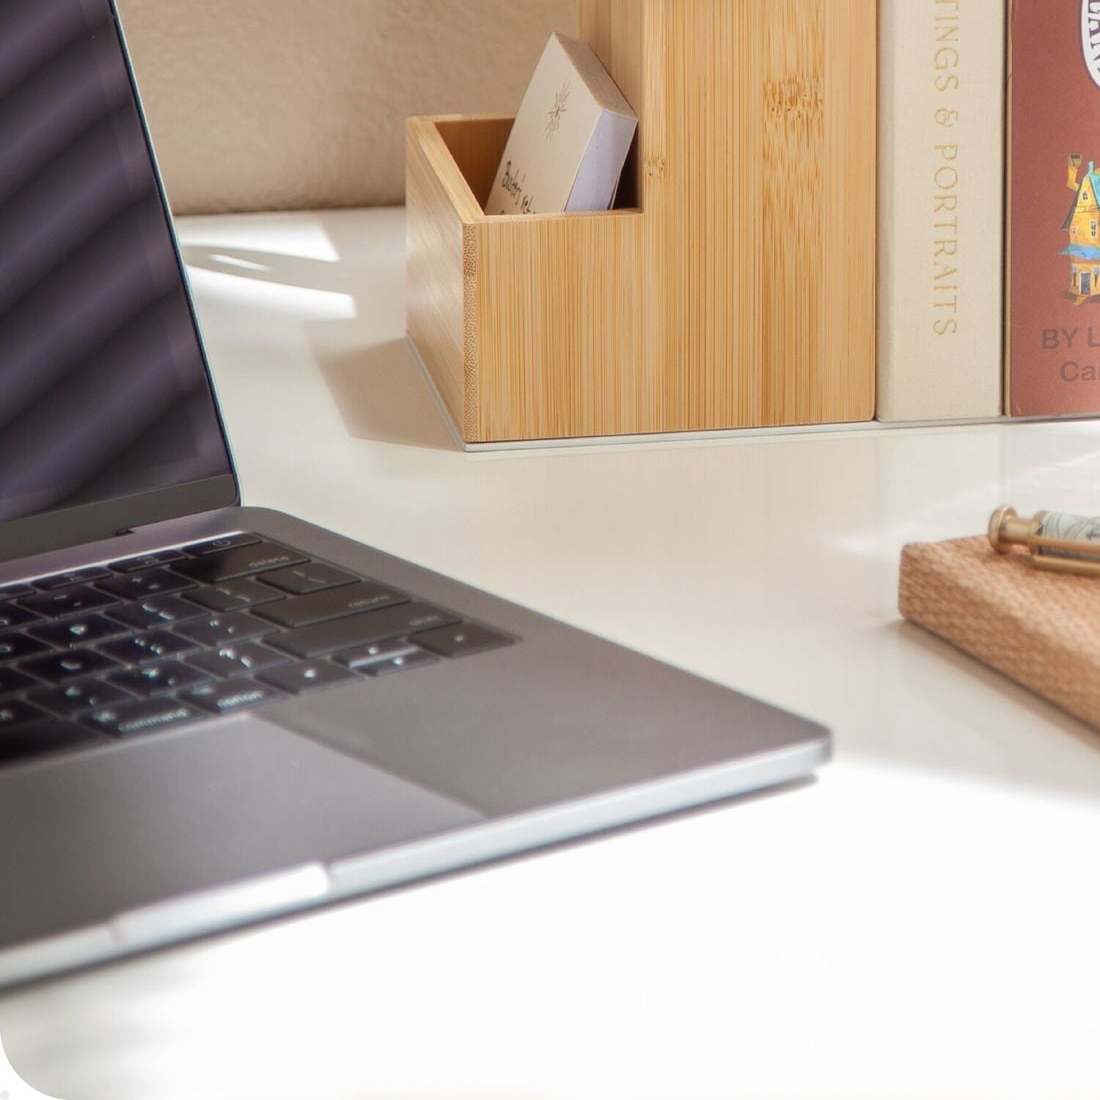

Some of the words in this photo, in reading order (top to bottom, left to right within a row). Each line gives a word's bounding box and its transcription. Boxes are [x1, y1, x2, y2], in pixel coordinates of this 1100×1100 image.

[934, 108, 959, 129] &
[933, 145, 959, 336] PORTRAITS
[1041, 327, 1079, 350] BY
